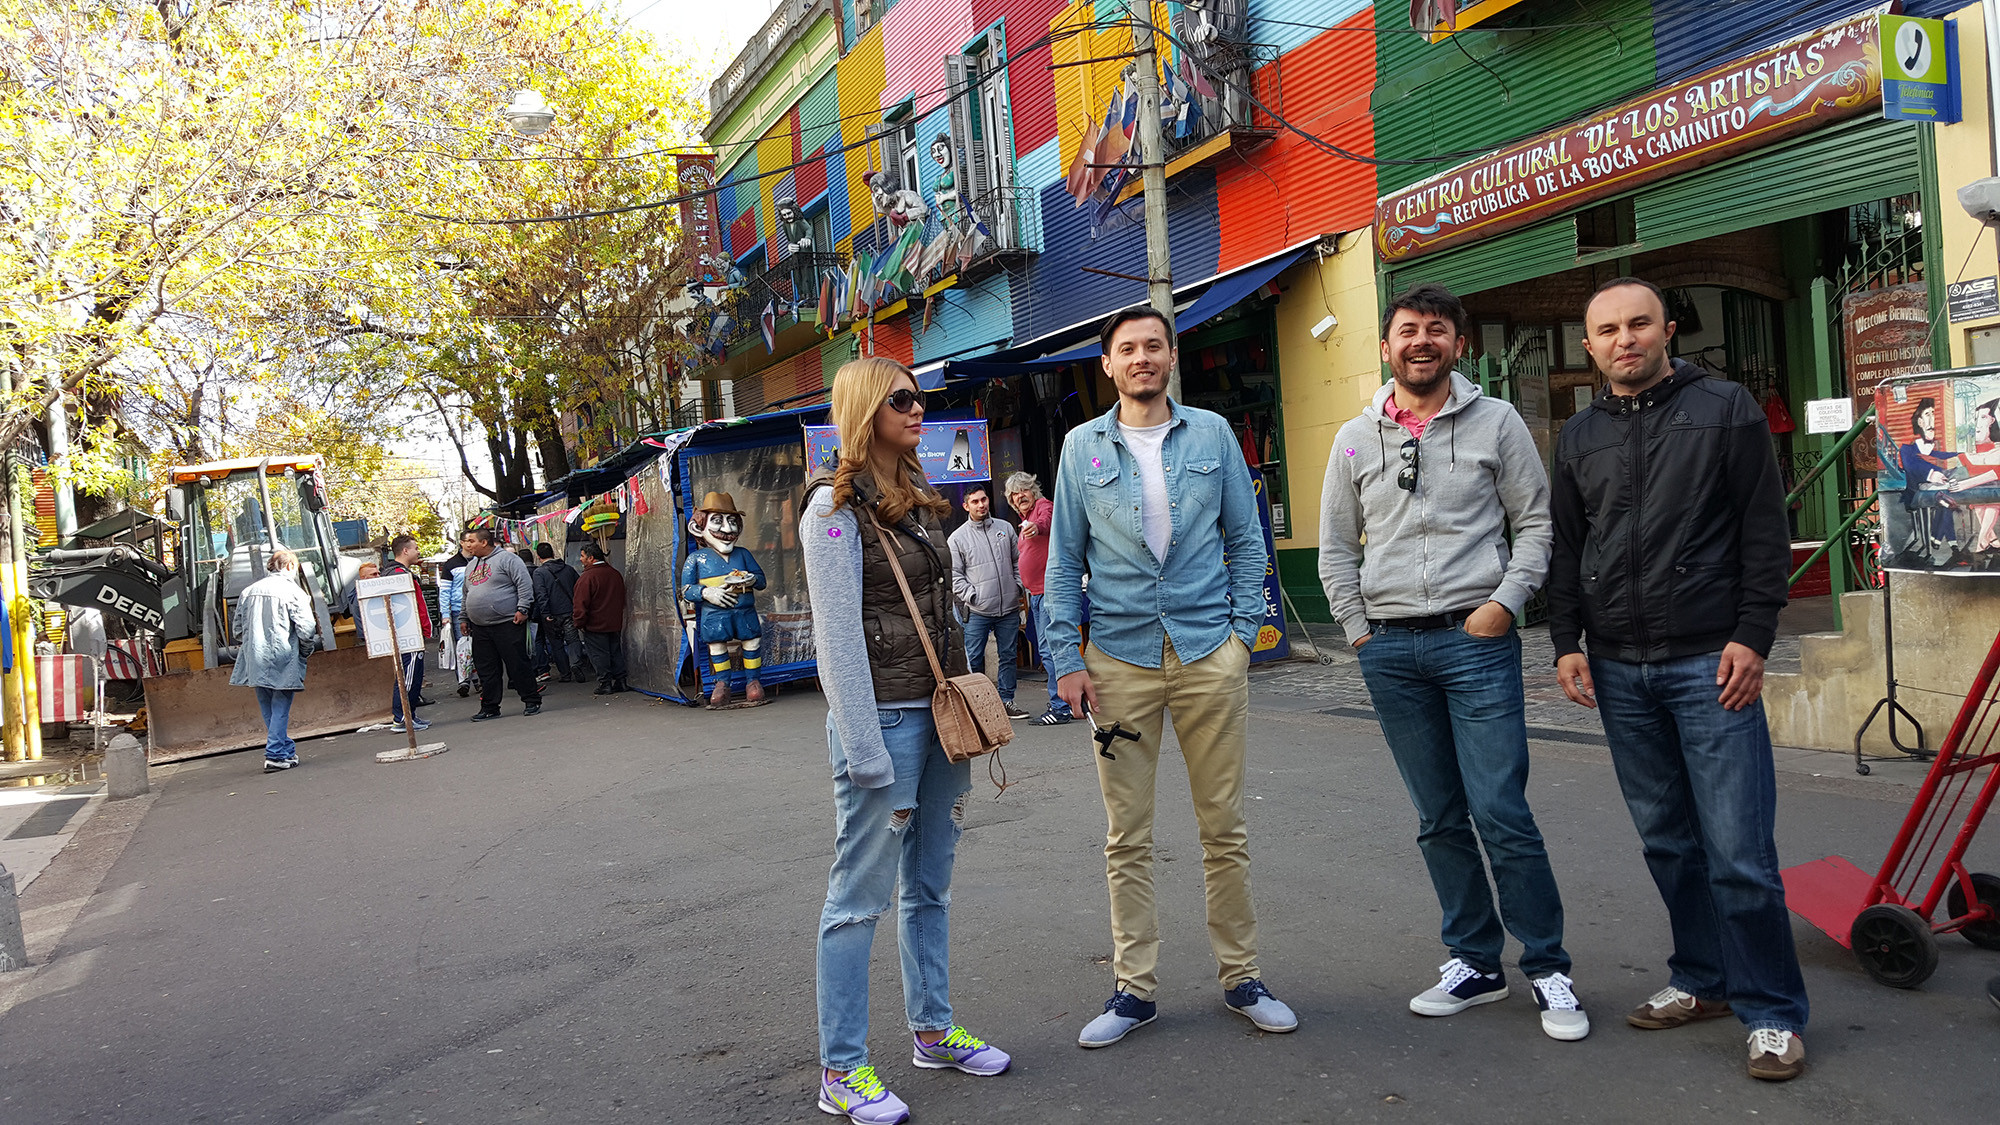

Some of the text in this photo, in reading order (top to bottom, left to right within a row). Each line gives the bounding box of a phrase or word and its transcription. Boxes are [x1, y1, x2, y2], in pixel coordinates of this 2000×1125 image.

[679, 165, 715, 185] CONVENTILLO
[1395, 177, 1464, 224] CENTRO
[1470, 137, 1572, 195] CULTURAL
[1622, 96, 1679, 139] LOS
[1452, 106, 1746, 225] REPUBLICA DE LA BOCA CAMINITO
[1855, 310, 1888, 334] WELCOME
[1855, 349, 1898, 365] CONVENTILLO
[96, 585, 165, 631] DEER
